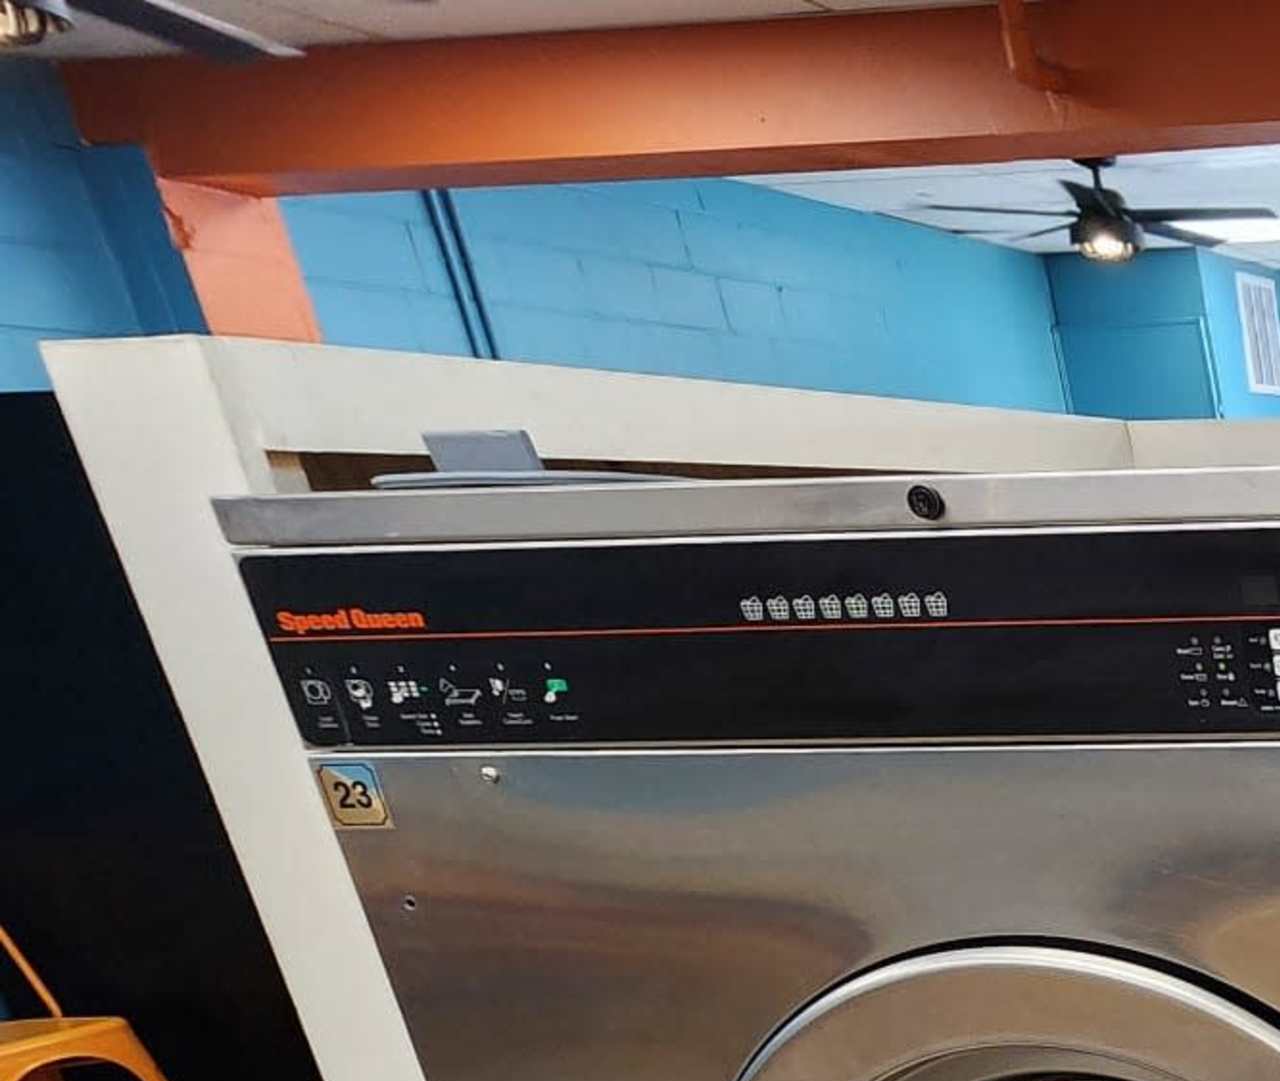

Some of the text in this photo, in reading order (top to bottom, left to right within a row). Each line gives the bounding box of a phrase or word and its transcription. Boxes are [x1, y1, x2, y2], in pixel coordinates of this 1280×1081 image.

[275, 607, 425, 635] Speed Queen
[333, 780, 373, 809] 23
